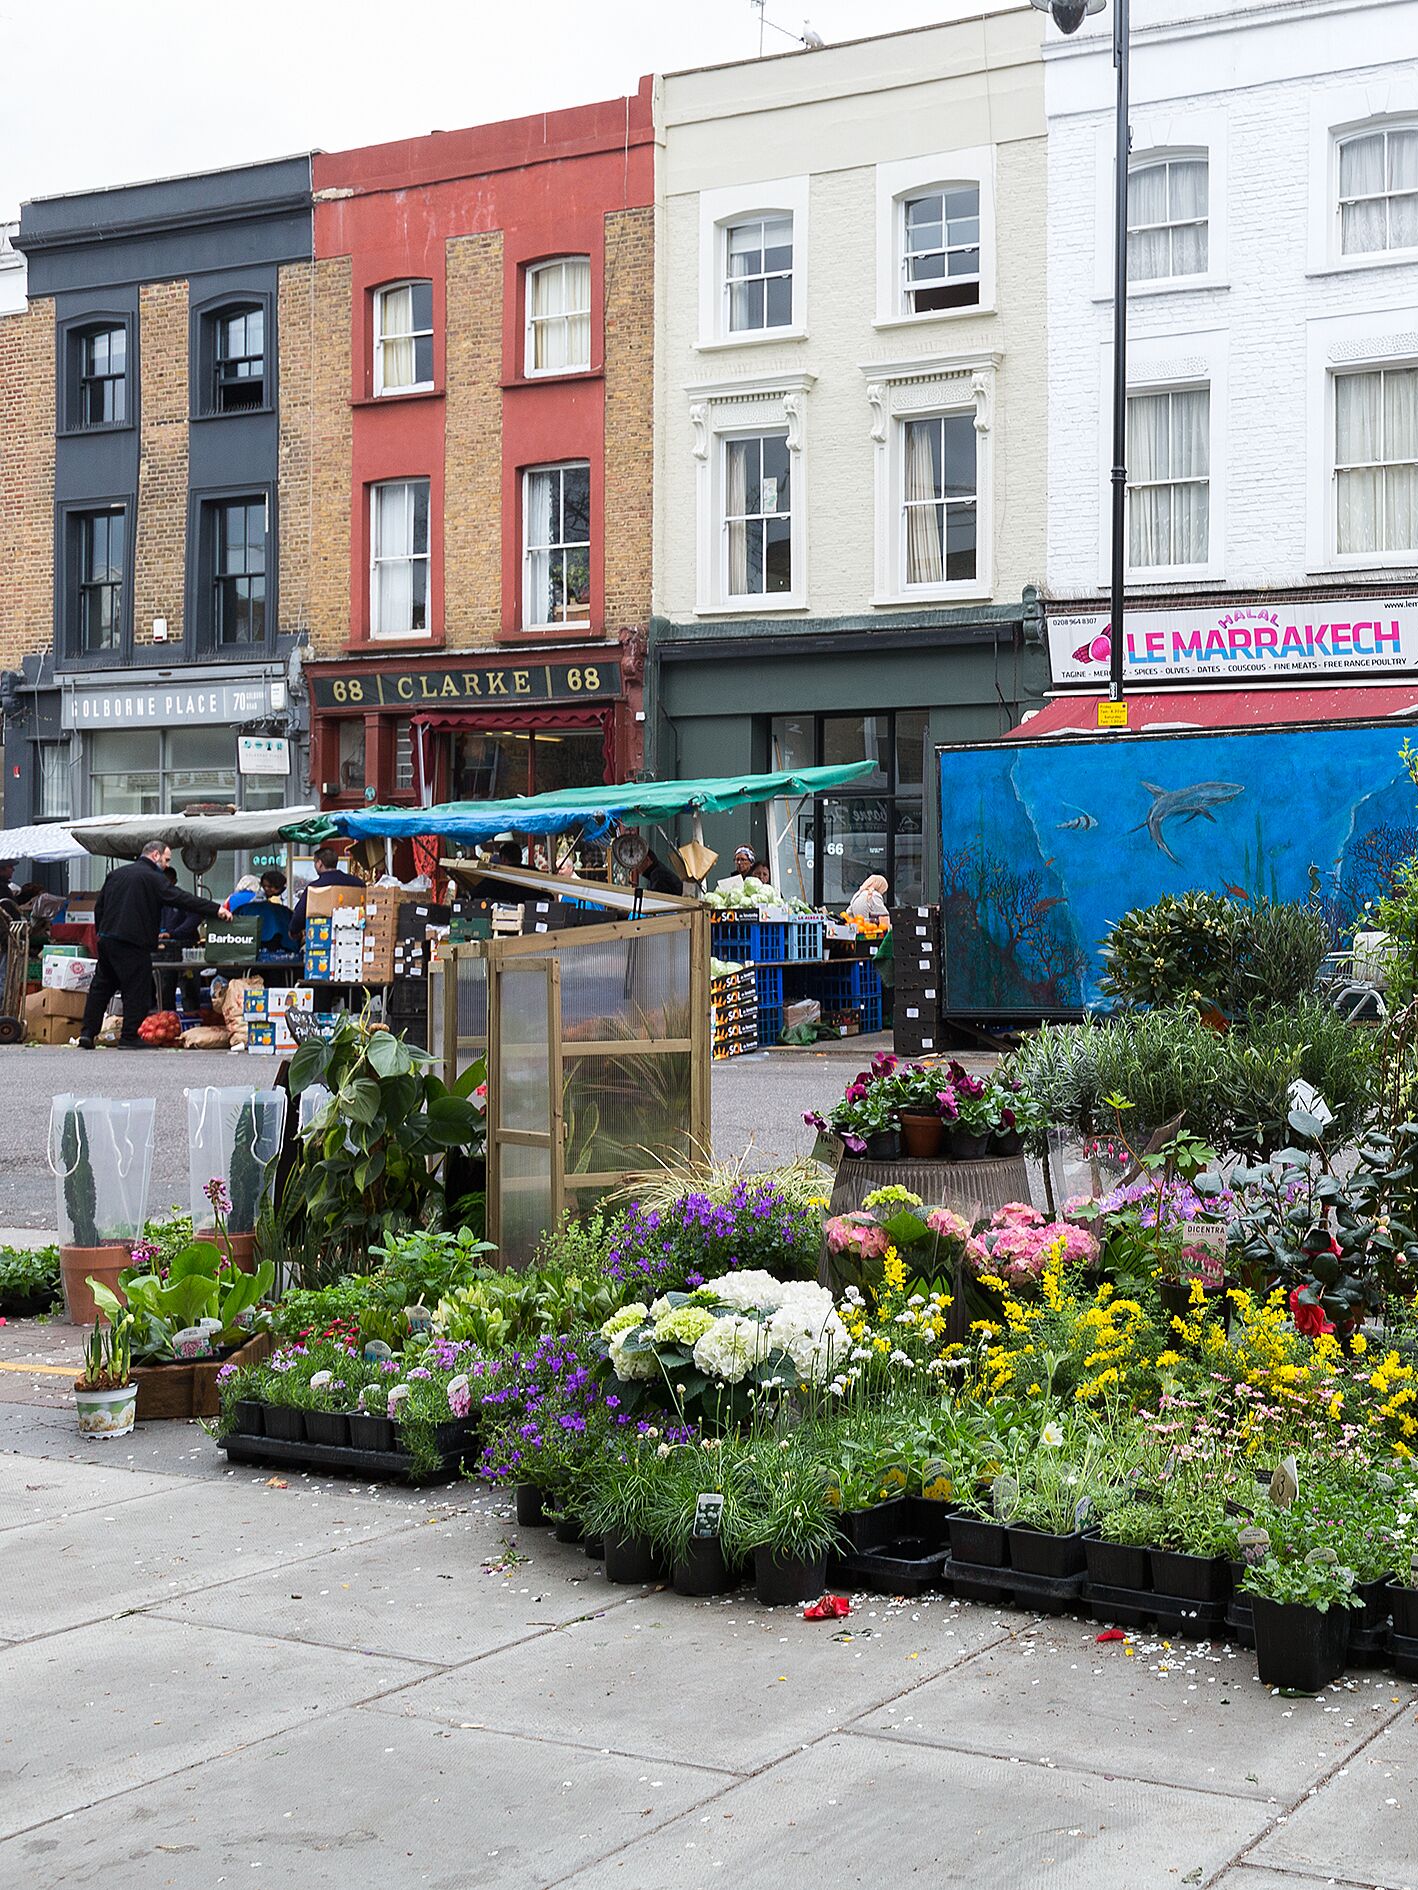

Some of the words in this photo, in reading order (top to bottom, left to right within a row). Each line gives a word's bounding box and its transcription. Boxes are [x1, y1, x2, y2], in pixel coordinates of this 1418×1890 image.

[1081, 617, 1097, 625] 8307
[1217, 607, 1279, 630] HALAL
[1126, 632, 1167, 664] LE
[1171, 620, 1401, 663] MARRAKECH
[1062, 670, 1086, 678] TAGINE
[1093, 668, 1127, 677] MERZ
[1134, 668, 1158, 676] SPICES
[1197, 665, 1220, 673] DATES
[1228, 664, 1266, 672] COUSCOUS
[1274, 662, 1290, 670] FINE
[1292, 661, 1317, 669] MEATS
[1324, 660, 1343, 668] FREE
[1344, 659, 1371, 667] RANGE
[1371, 658, 1406, 666] POULTRY
[332, 679, 363, 702] 68
[397, 670, 531, 699] CLARKE
[567, 667, 601, 691] 68
[165, 694, 217, 715] PLACE
[233, 692, 246, 711] 70
[827, 843, 844, 856] 66
[721, 910, 739, 922] SOL
[208, 932, 254, 945] Barbour
[726, 974, 741, 988] SOL
[726, 991, 741, 1004] SOL
[728, 1008, 743, 1022] SOL
[728, 1024, 743, 1038] SOL
[729, 1042, 744, 1056] SOL
[1187, 1225, 1225, 1234] DICENTRA
[1277, 1474, 1286, 1497] 3
